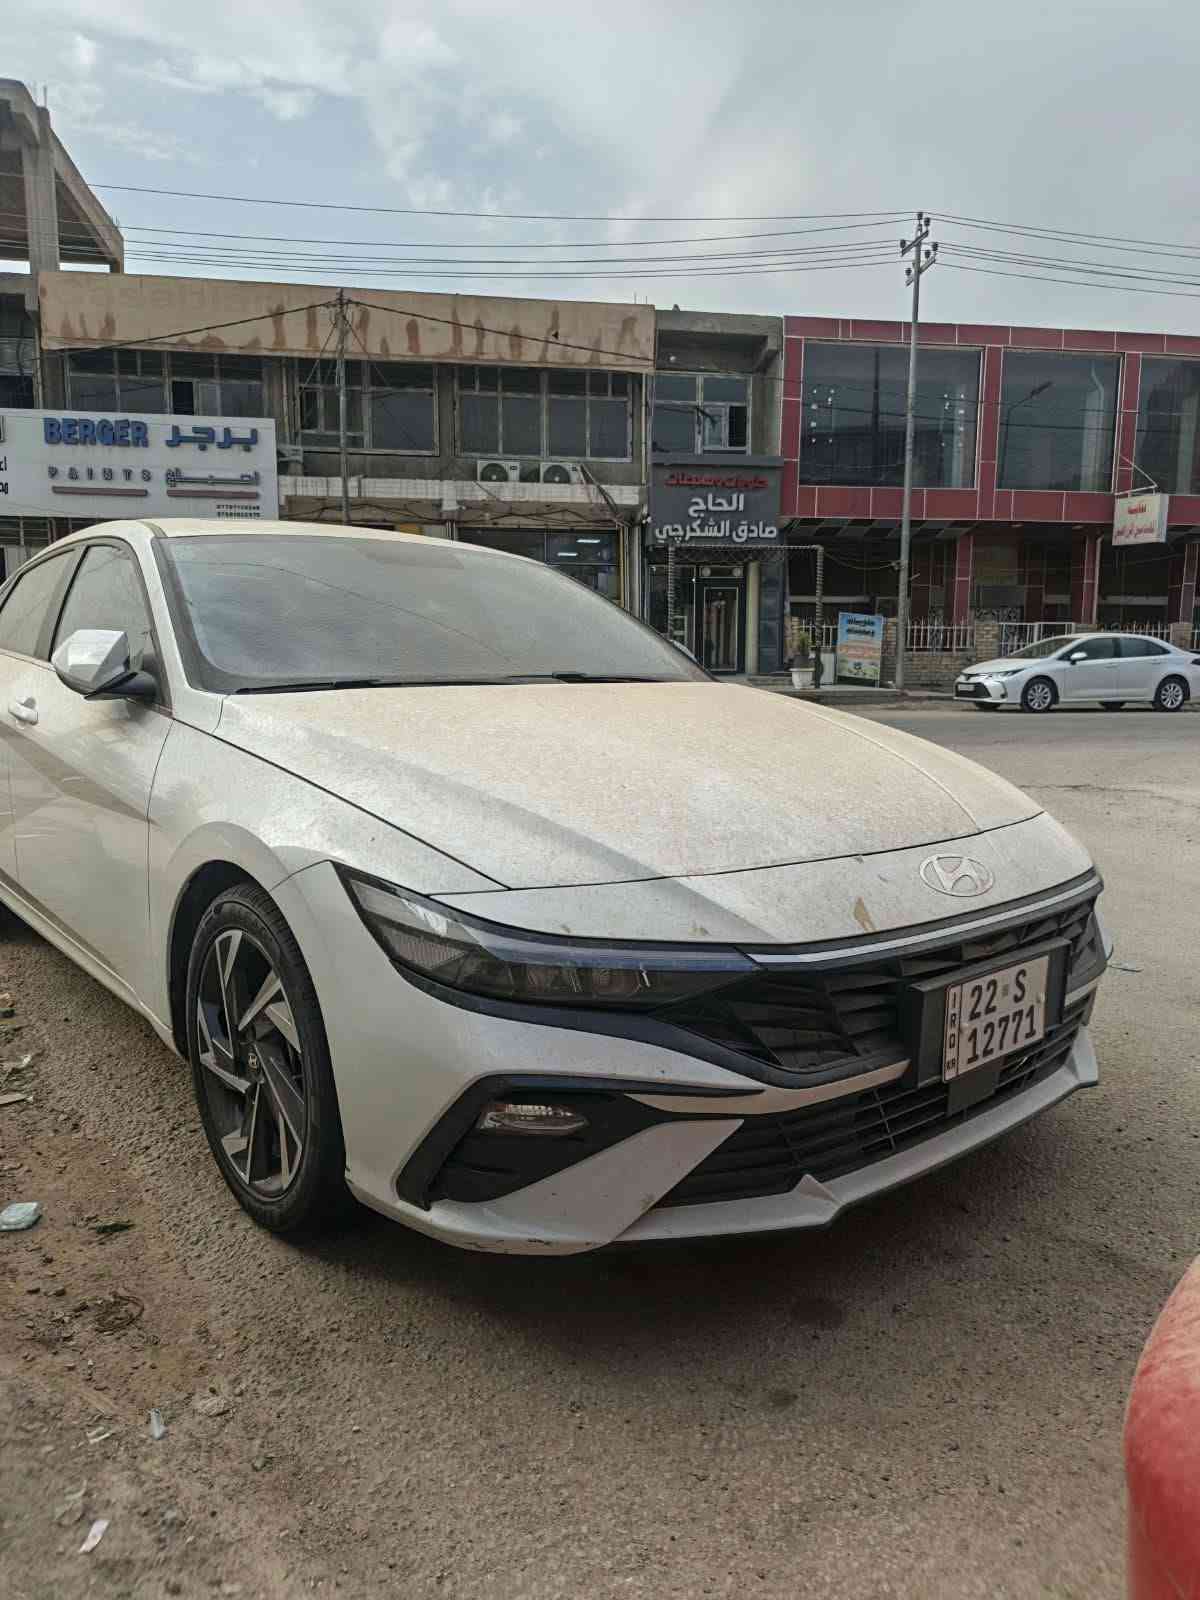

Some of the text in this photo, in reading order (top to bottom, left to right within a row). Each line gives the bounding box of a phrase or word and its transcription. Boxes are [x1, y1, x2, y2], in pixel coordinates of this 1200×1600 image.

[43, 417, 149, 448] BERGER
[165, 425, 259, 451] برجر
[48, 467, 152, 482] PAINTS
[688, 493, 745, 517] الحاج
[732, 520, 777, 542] صادق
[969, 969, 1027, 1020] 22 S
[967, 1004, 1037, 1064] 12771
